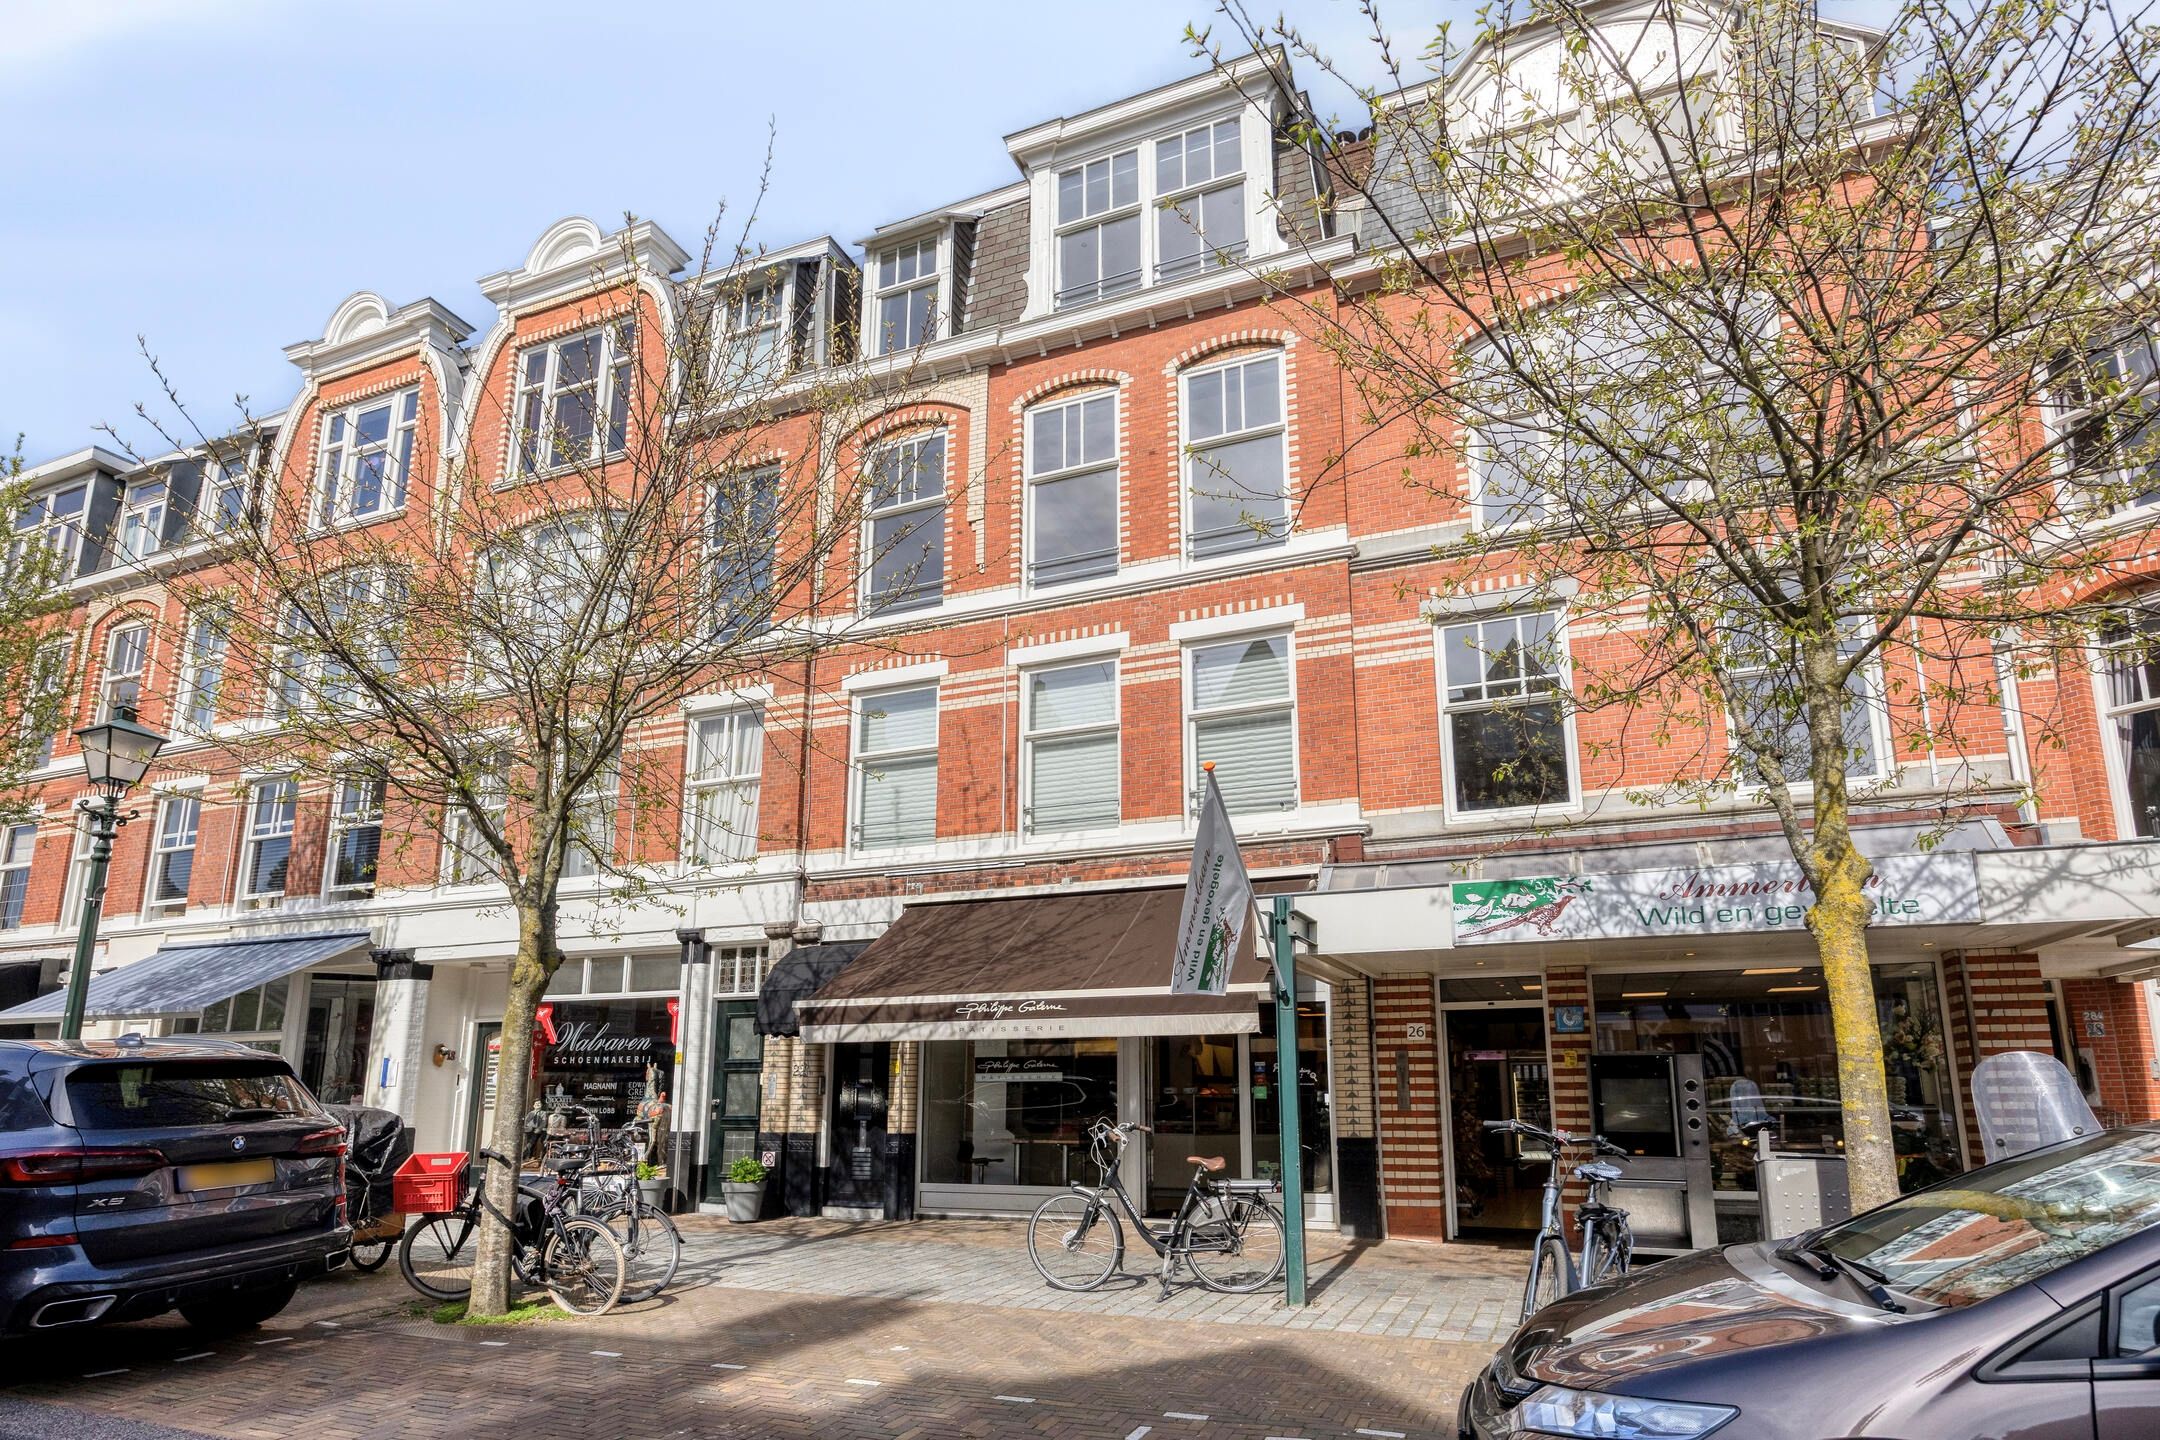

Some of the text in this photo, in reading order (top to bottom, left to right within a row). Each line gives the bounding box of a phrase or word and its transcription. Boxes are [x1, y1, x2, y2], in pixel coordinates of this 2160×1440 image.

[1660, 871, 1889, 901] Ammerln
[1637, 896, 1920, 926] Wild en gelte
[1187, 854, 1225, 983] Wild en gevogelte
[556, 1021, 652, 1052] Walraven
[1408, 1026, 1425, 1038] 26
[554, 1055, 651, 1064] SCHOENMAKERIJ
[583, 1082, 618, 1090] MAGNANNI
[627, 1088, 645, 1096] GRE
[87, 1197, 125, 1208] X5
